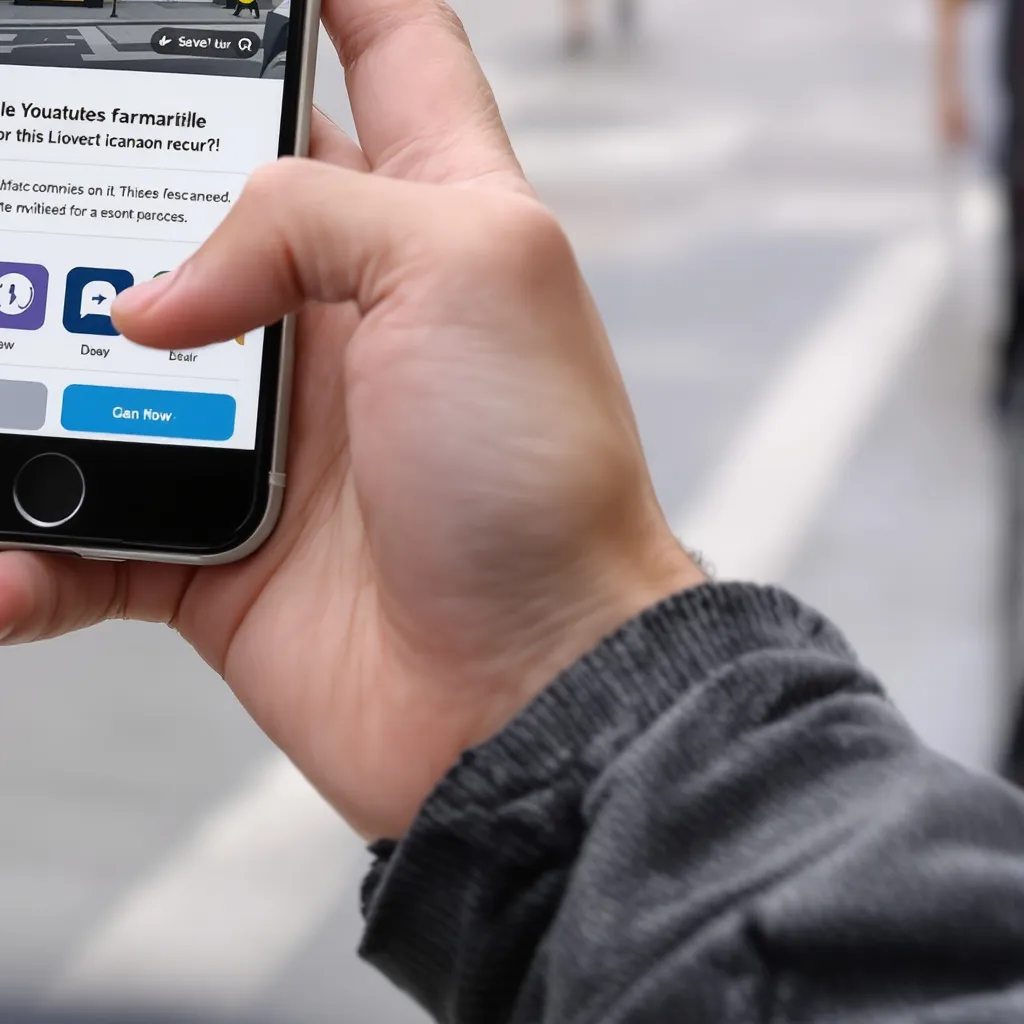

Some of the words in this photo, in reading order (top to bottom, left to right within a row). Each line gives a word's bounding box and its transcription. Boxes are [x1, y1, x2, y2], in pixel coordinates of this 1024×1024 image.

[21, 102, 106, 123] Youatutes
[16, 128, 44, 144] this
[87, 185, 103, 196] on
[69, 204, 88, 217] for
[89, 208, 98, 218] a
